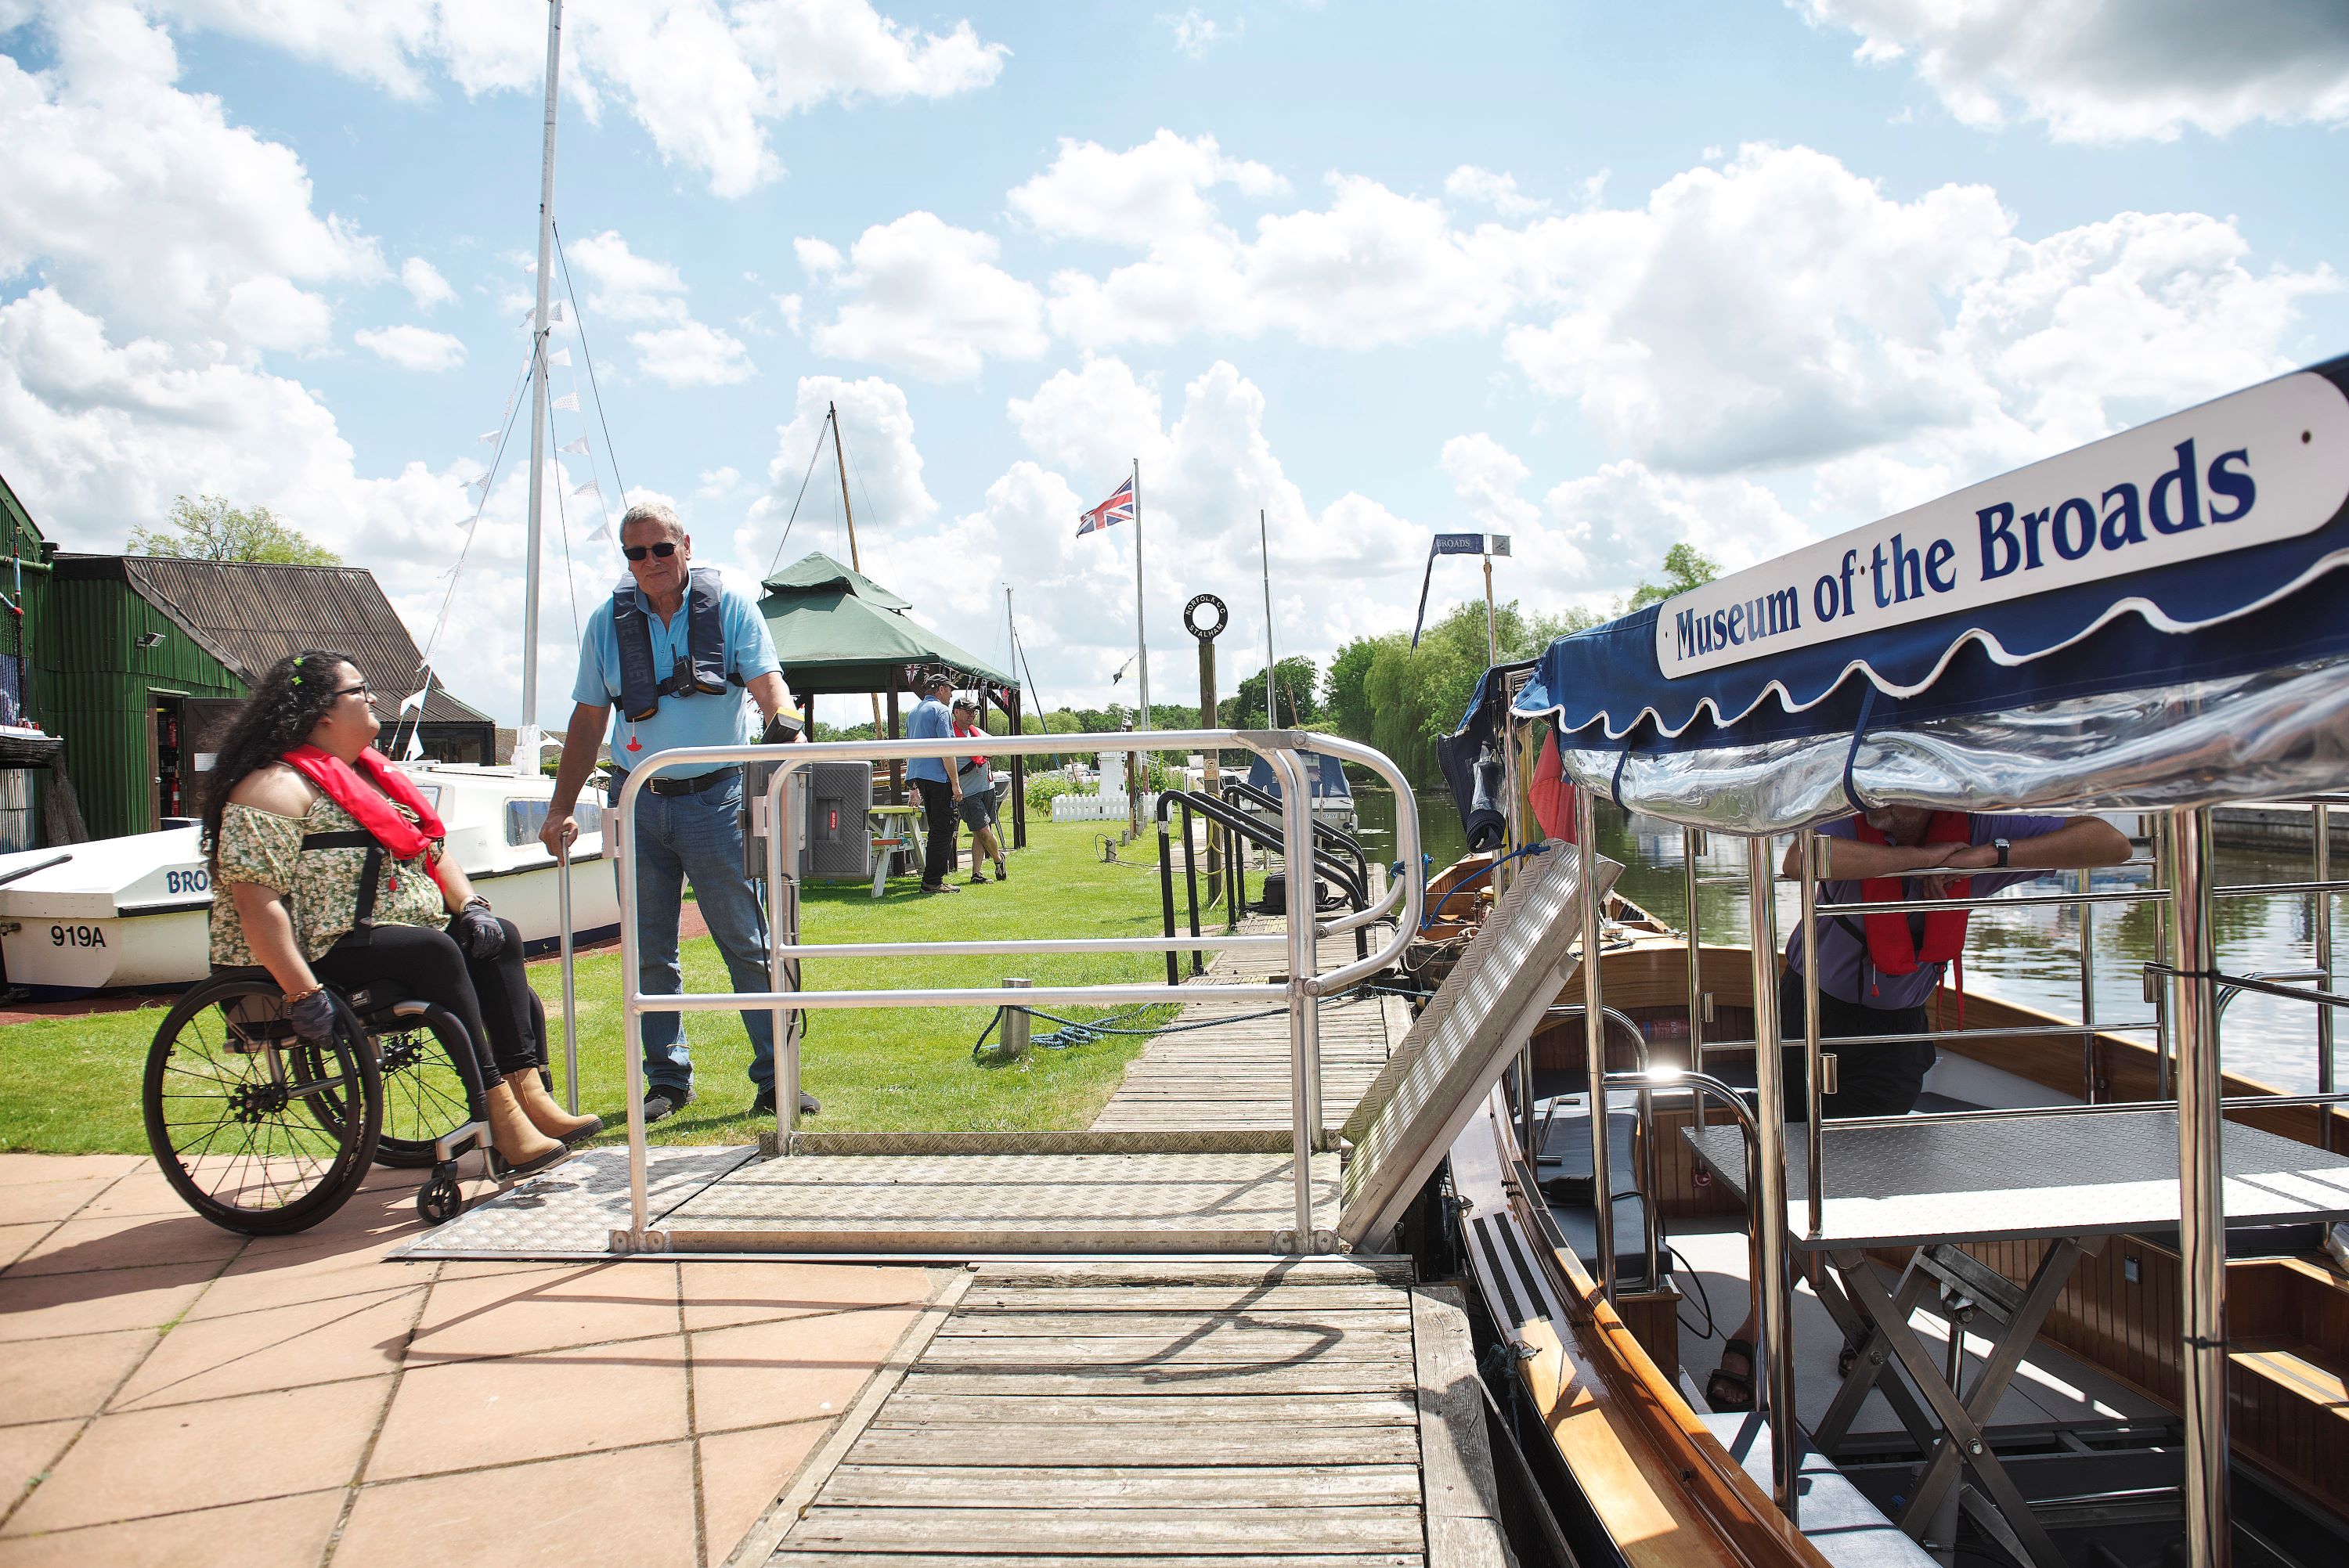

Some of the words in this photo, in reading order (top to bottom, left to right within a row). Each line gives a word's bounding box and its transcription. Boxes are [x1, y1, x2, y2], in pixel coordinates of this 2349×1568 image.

[1436, 539, 1471, 547] BROADS
[1676, 585, 1801, 661] Museum
[1813, 550, 1856, 622] of
[1872, 533, 1957, 609] the
[1976, 438, 2257, 582] Broads
[1185, 595, 1216, 615] NORFOLK
[1189, 622, 1224, 637] STALHAM
[626, 639, 648, 684] JACKET
[166, 870, 212, 894] BRO
[50, 925, 106, 948] 919A
